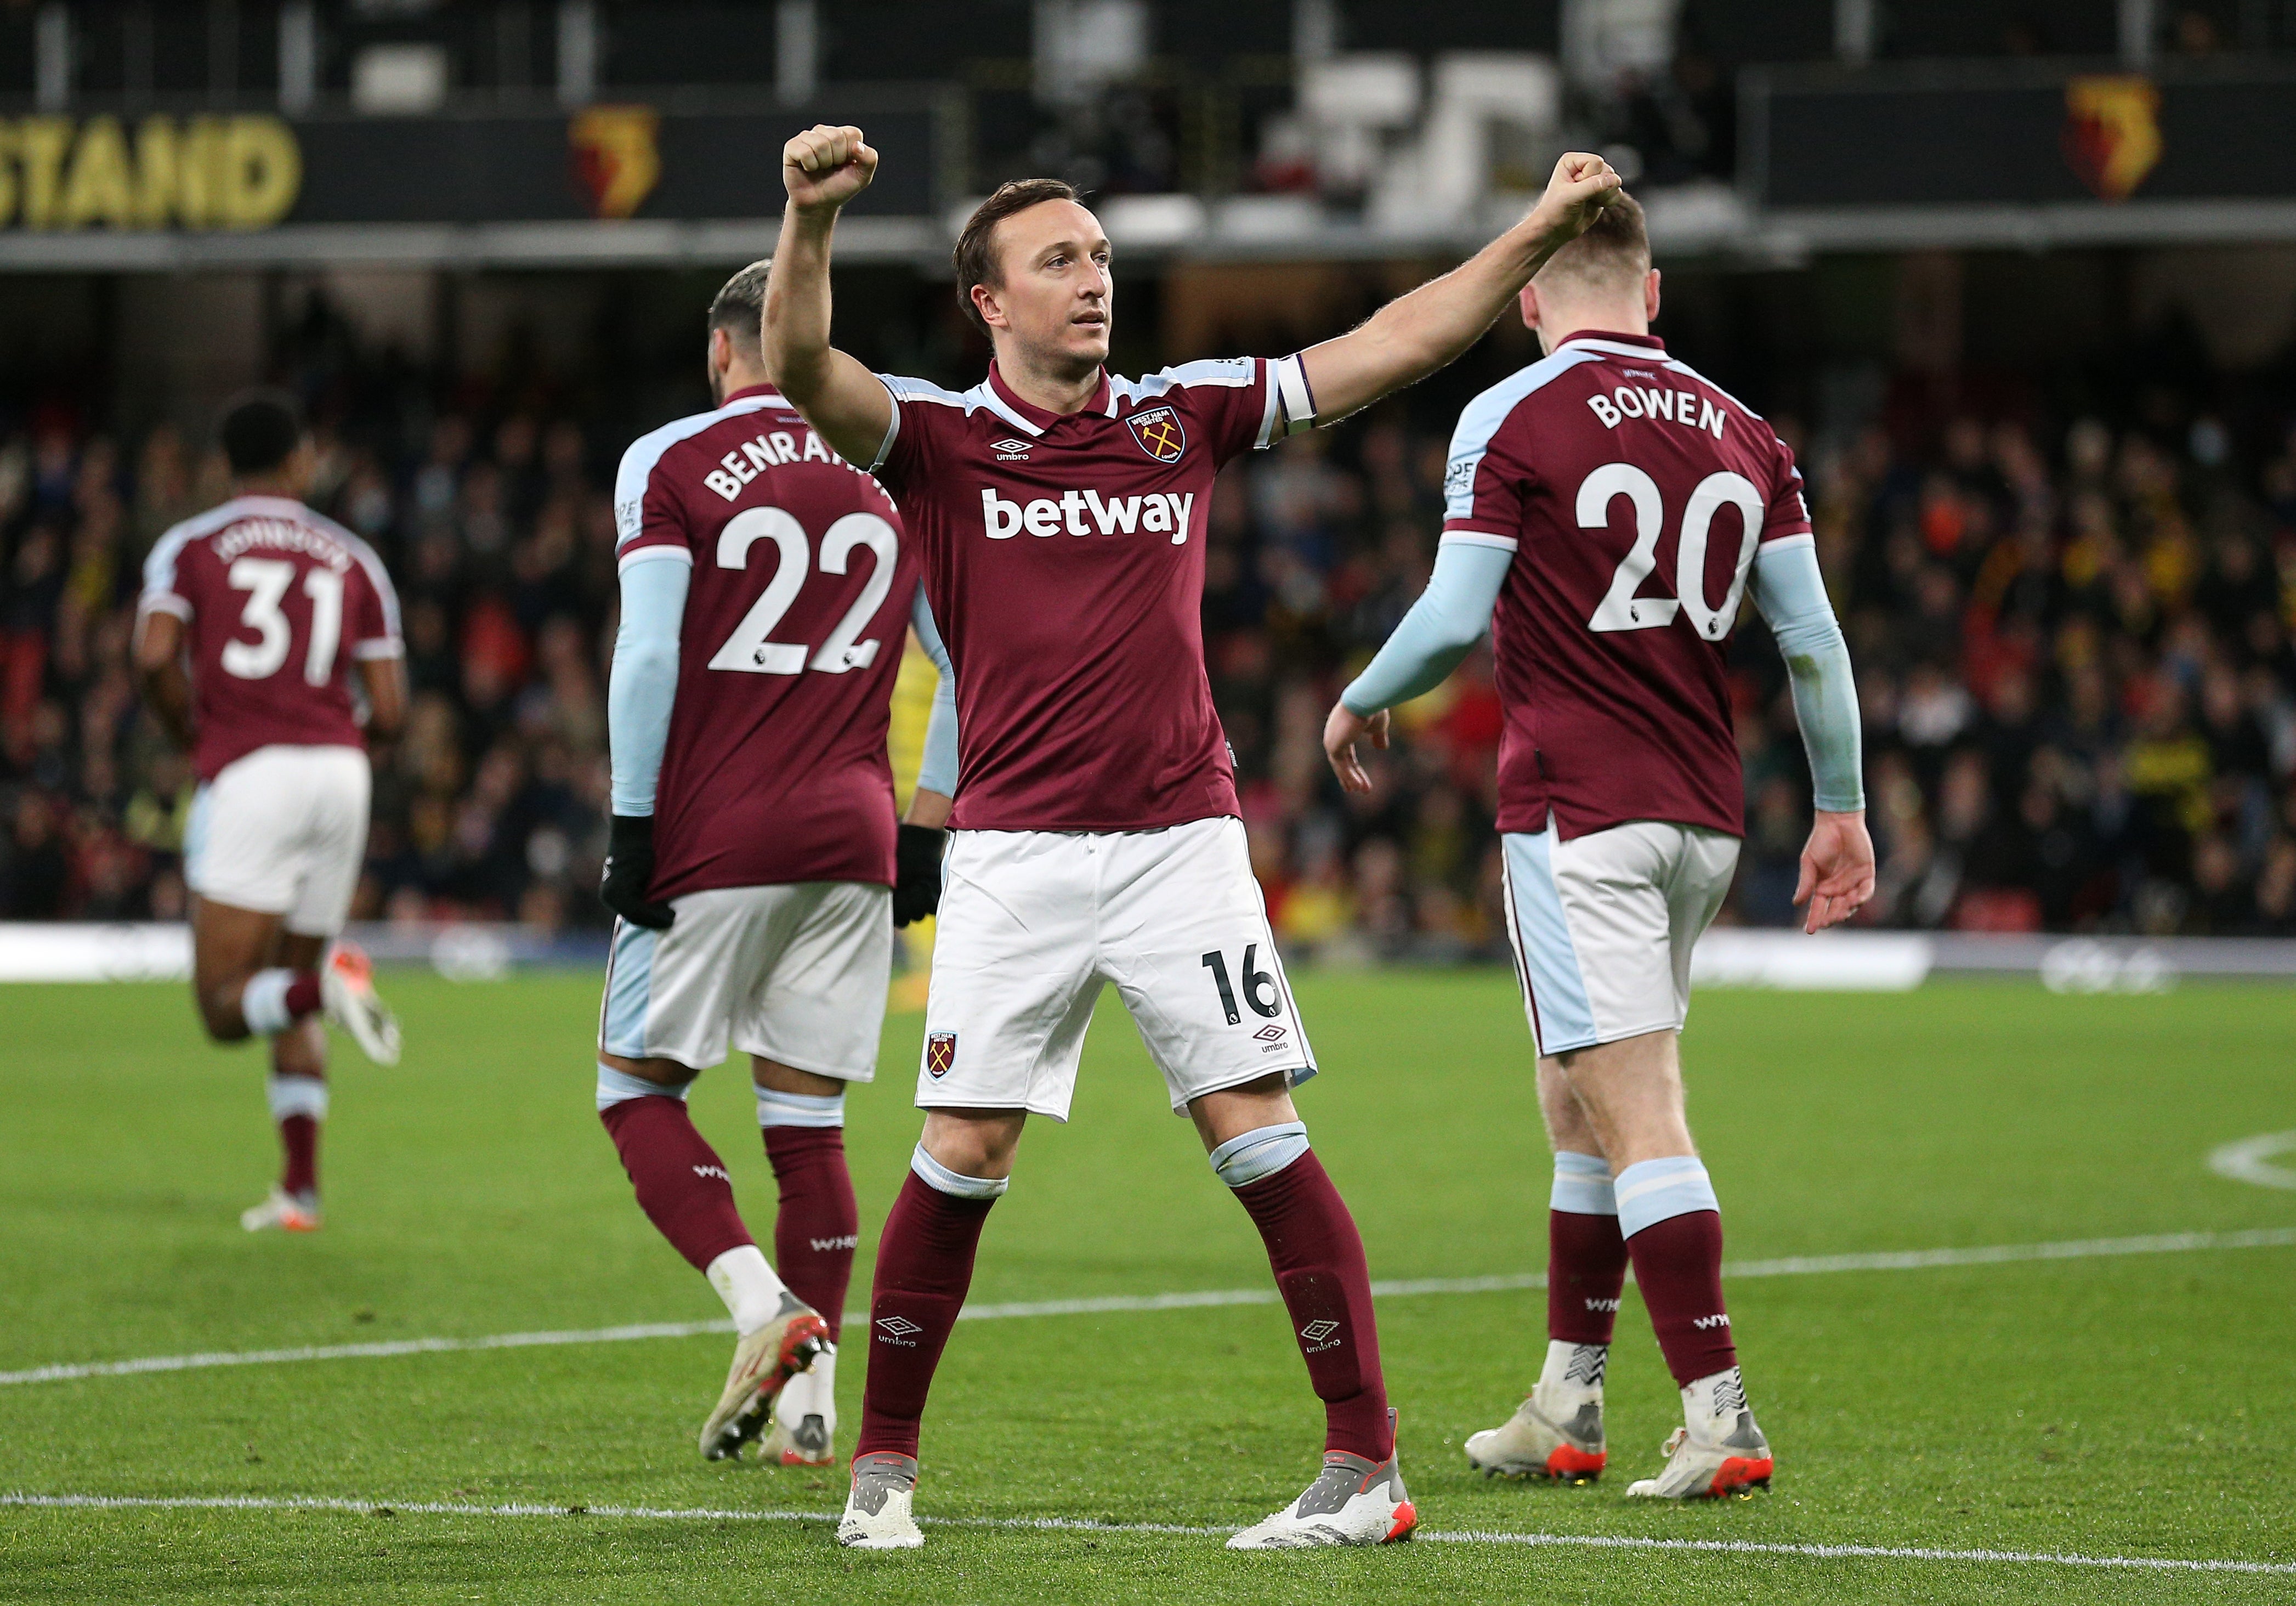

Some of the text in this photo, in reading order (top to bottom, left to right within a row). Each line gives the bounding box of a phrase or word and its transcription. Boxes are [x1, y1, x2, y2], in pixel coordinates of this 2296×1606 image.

[1131, 410, 1170, 426] WEST HAM
[1141, 416, 1164, 427] UNITED
[1586, 386, 1726, 440] BOWEN
[981, 488, 1194, 546] betway
[1575, 462, 1765, 641] 20
[707, 506, 899, 674] 22
[221, 556, 344, 688] 31
[1202, 943, 1282, 1026] 16
[1262, 1042, 1288, 1053] umbro
[878, 1334, 916, 1347] umbro
[1306, 1339, 1341, 1353] umbro
